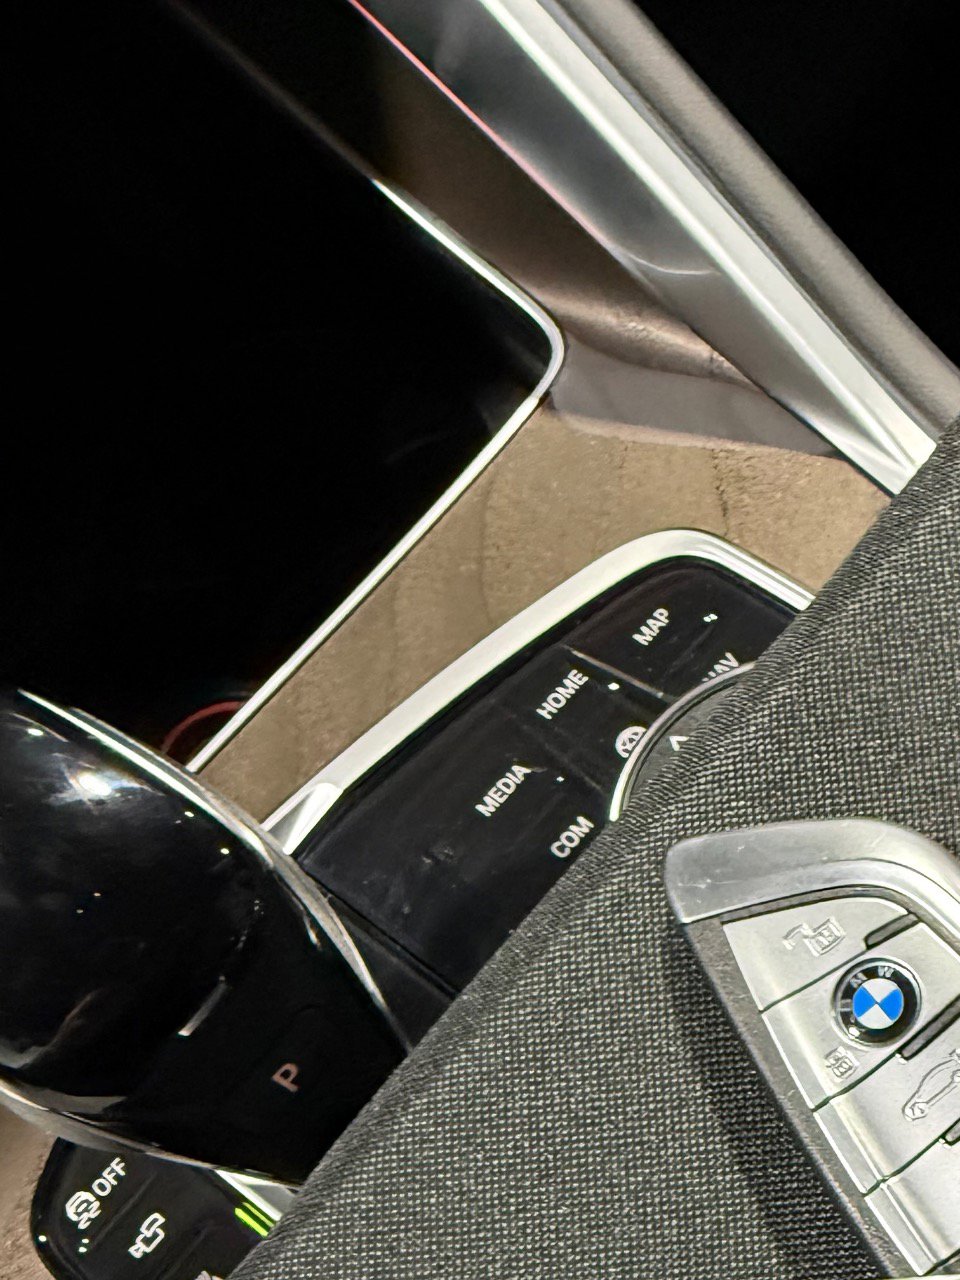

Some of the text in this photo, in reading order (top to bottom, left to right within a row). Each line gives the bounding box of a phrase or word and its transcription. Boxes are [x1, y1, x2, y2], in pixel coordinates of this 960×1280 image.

[632, 608, 669, 646] MAP
[702, 652, 740, 682] AV
[536, 669, 589, 720] HOME
[475, 764, 531, 817] MEDIA
[550, 815, 595, 858] COM
[271, 1062, 299, 1093] P
[92, 1157, 127, 1197] OFF
